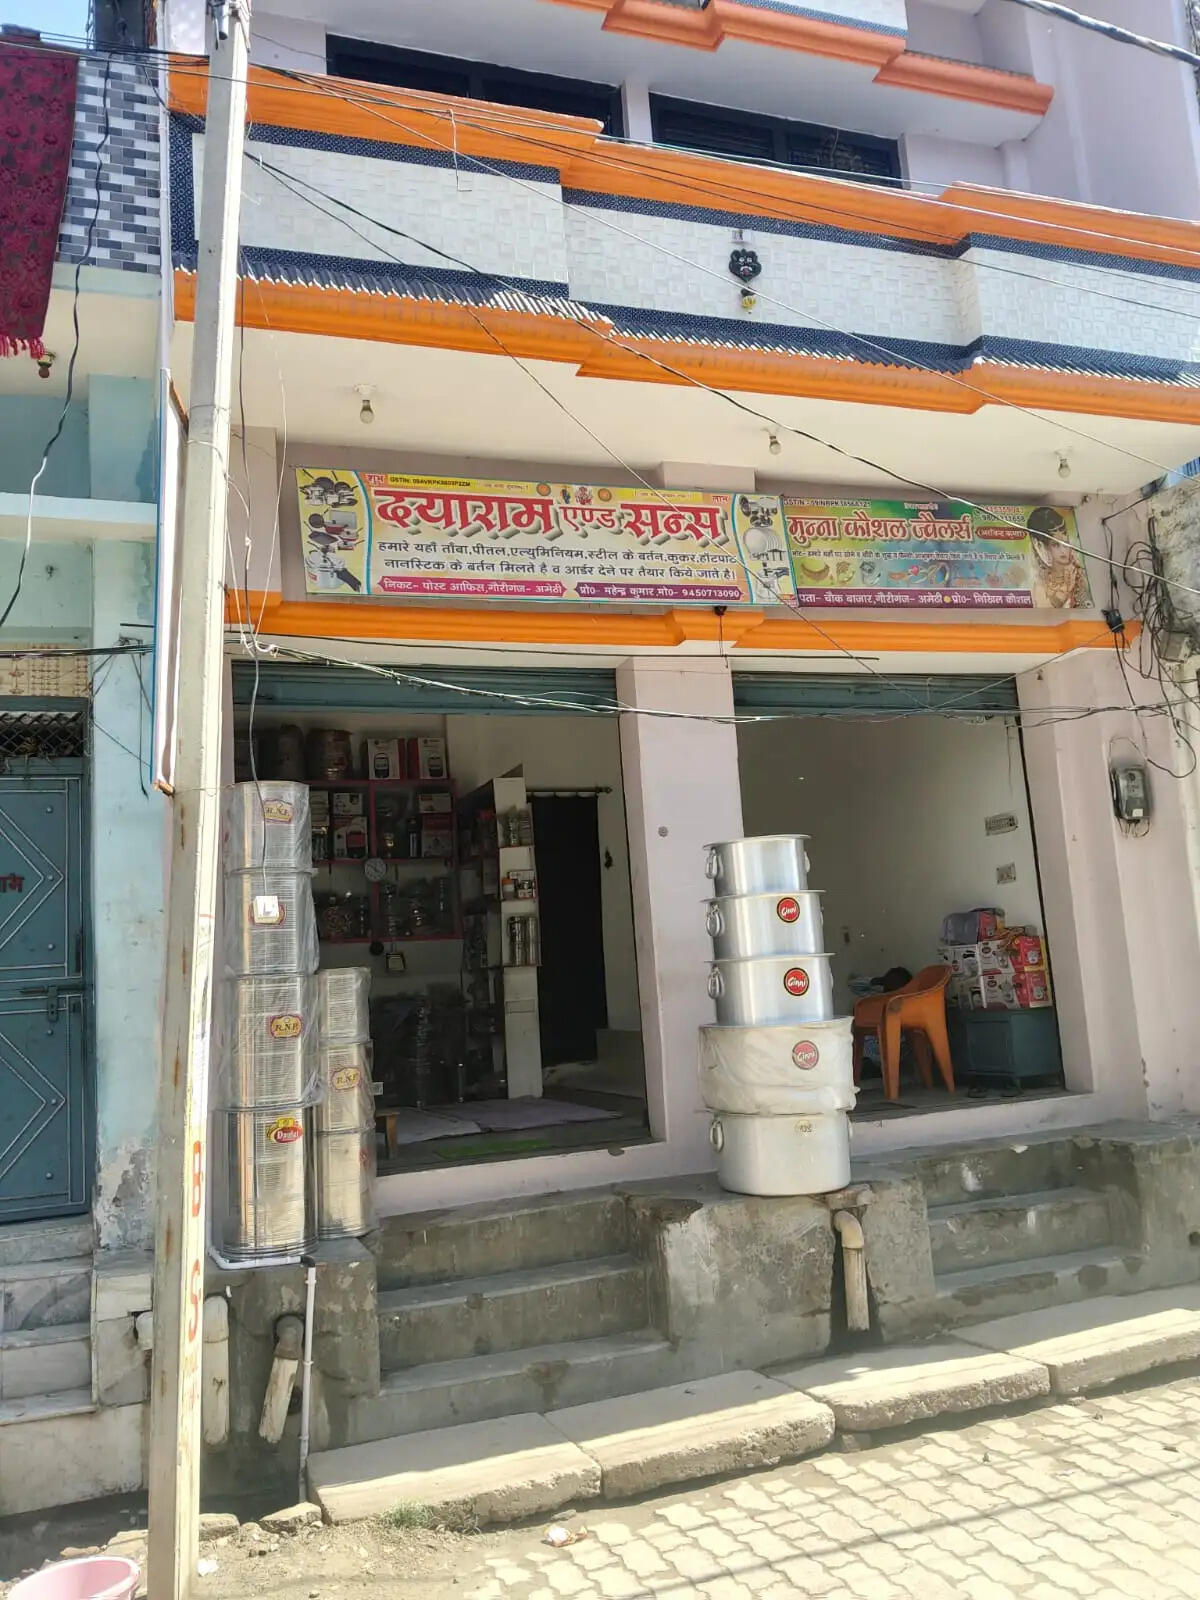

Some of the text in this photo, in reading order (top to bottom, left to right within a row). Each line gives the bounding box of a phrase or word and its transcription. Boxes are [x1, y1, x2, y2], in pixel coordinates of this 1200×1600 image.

[711, 495, 728, 505] लाभ
[374, 490, 720, 541] दयाराम एण्ड सन्स
[786, 510, 972, 545] मुन्ना कौशल ज्वैलर्स
[378, 540, 409, 552] हमारे
[414, 541, 437, 553] यहाँ
[621, 548, 634, 560] के
[384, 557, 445, 570] नानस्टिक
[449, 559, 463, 570] के
[467, 559, 495, 572] बर्तन
[499, 560, 536, 574] मिलते
[552, 563, 560, 574] व
[564, 563, 594, 576] आर्डर
[598, 563, 616, 577] देने
[620, 567, 634, 577] पर
[638, 565, 665, 578] तैयार
[669, 565, 693, 578] किये
[696, 566, 720, 579] जाते
[422, 580, 447, 591] पोस्ट
[535, 583, 562, 594] अमेठी
[604, 585, 627, 597] महेन्द्र
[681, 588, 740, 598] 9450713090
[824, 591, 843, 604] चौक
[918, 592, 943, 604] अमेठी
[973, 592, 1003, 604] निखिल
[1005, 592, 1032, 604] कौशल
[787, 976, 805, 987] Ginni
